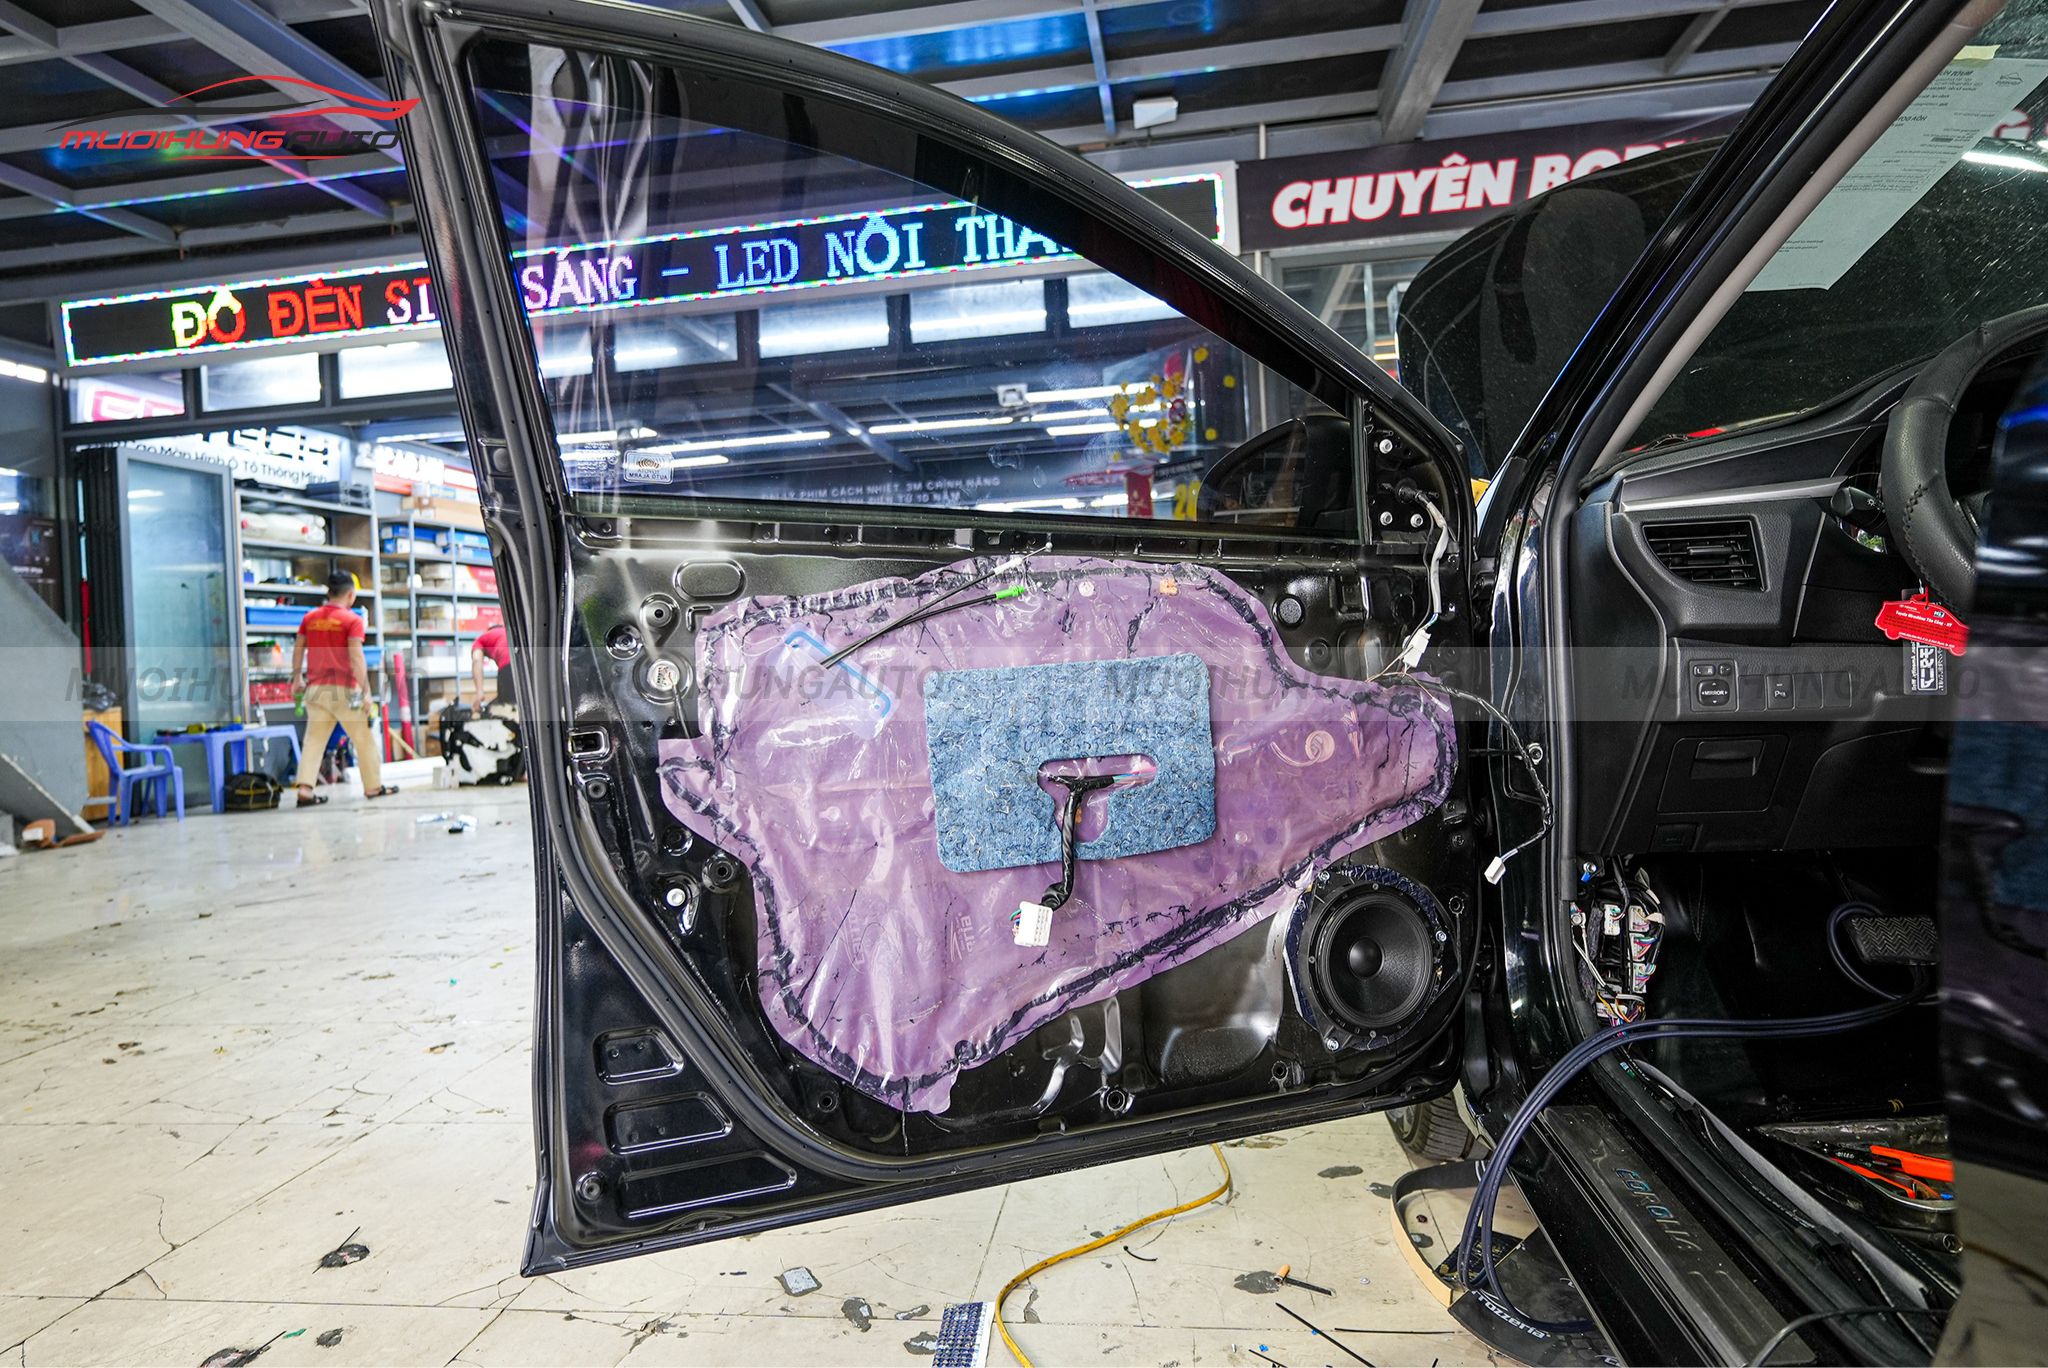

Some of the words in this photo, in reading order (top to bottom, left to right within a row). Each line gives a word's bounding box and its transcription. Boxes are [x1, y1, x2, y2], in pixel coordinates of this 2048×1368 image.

[1272, 152, 1519, 229] CHUYÊN
[1527, 138, 1696, 200] BO
[267, 278, 364, 338] ĐÈN
[384, 277, 437, 324] SI
[521, 251, 638, 310] SÁNG
[714, 238, 800, 290] LED
